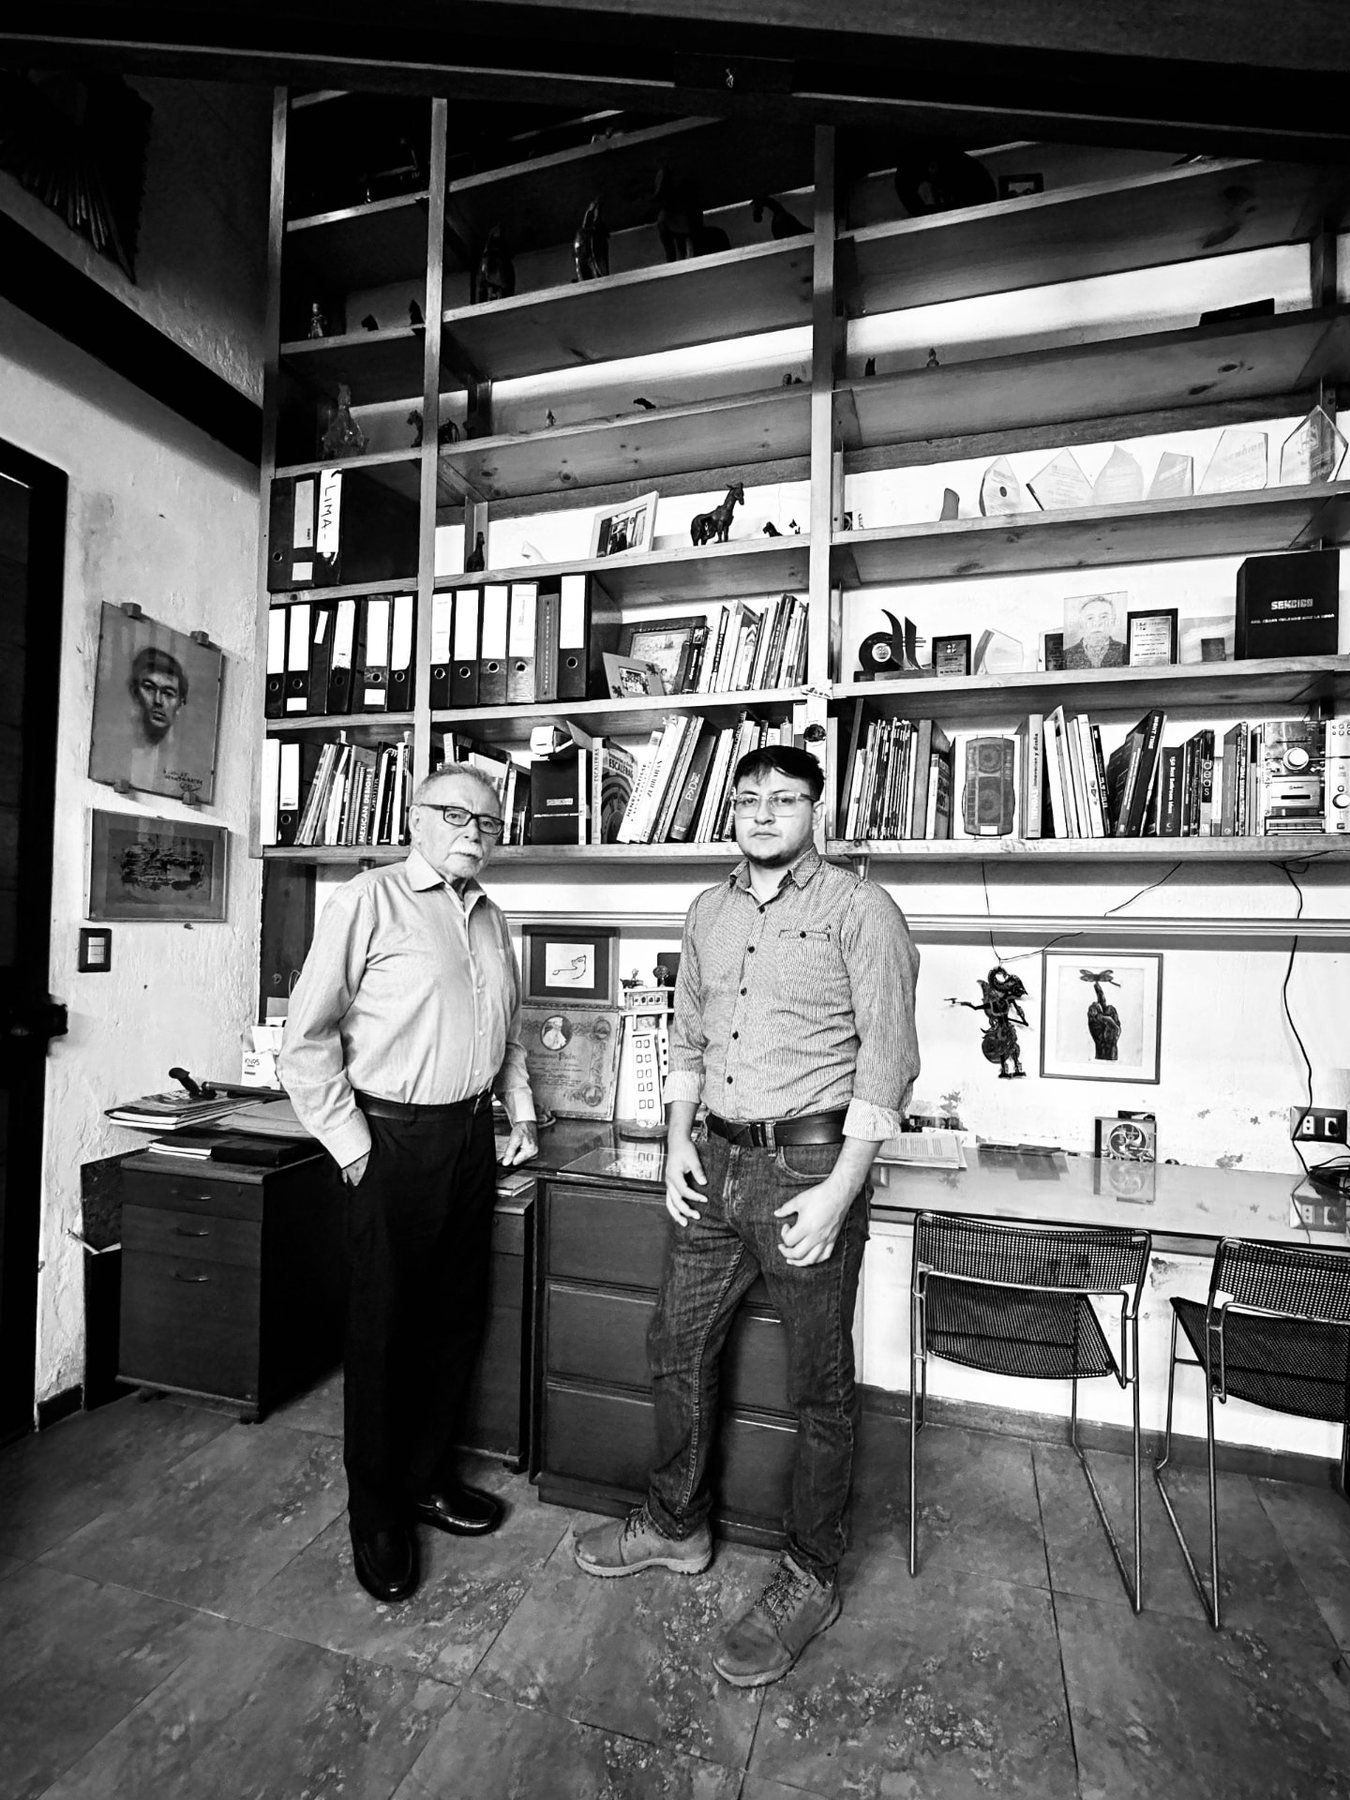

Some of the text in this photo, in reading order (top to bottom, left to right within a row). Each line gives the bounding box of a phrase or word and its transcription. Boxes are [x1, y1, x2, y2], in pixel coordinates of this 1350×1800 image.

[320, 485, 337, 529] LIMA
[609, 758, 633, 779] ESCALERAS
[363, 774, 373, 804] DESIGN
[626, 795, 637, 817] HENRI
[635, 764, 647, 793] MATISSE
[358, 805, 369, 843] MEXICAN
